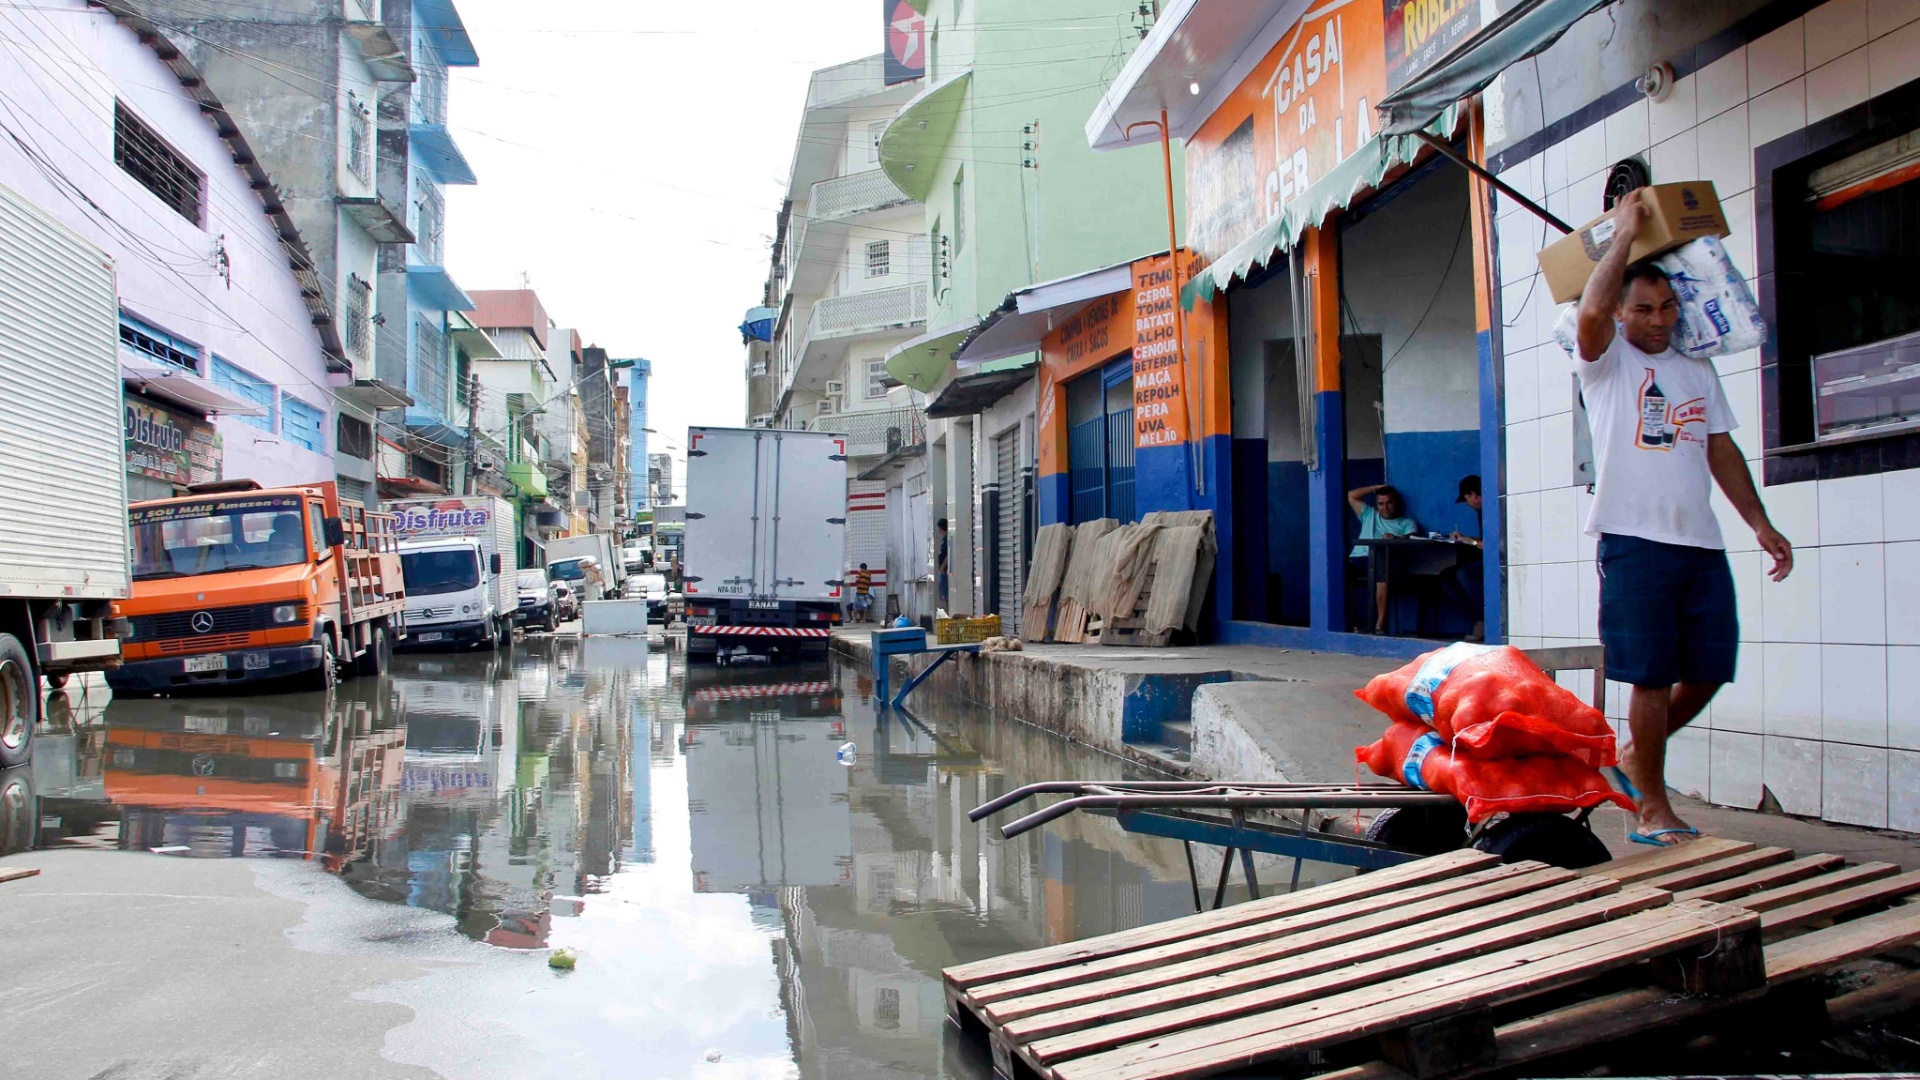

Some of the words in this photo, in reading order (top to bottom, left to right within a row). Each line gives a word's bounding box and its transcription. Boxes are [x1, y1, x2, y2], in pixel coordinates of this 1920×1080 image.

[1277, 18, 1340, 115] CASA
[1299, 96, 1316, 136] DA
[1136, 286, 1172, 304] CEBOL
[1137, 298, 1173, 315] TOMA
[1137, 325, 1174, 344] ALHO
[1133, 339, 1179, 360] CENOUR
[1135, 367, 1171, 389] MAÇÃ
[1136, 384, 1179, 404] REPOLH
[1137, 402, 1169, 419] PERA
[124, 403, 182, 453] Disfruta
[1138, 418, 1165, 434] UVA
[1139, 427, 1177, 447] MELÃO
[147, 508, 175, 518] SOU
[179, 504, 214, 514] MAIS
[388, 508, 487, 531] Disfruta
[717, 586, 744, 594] NPA-5815
